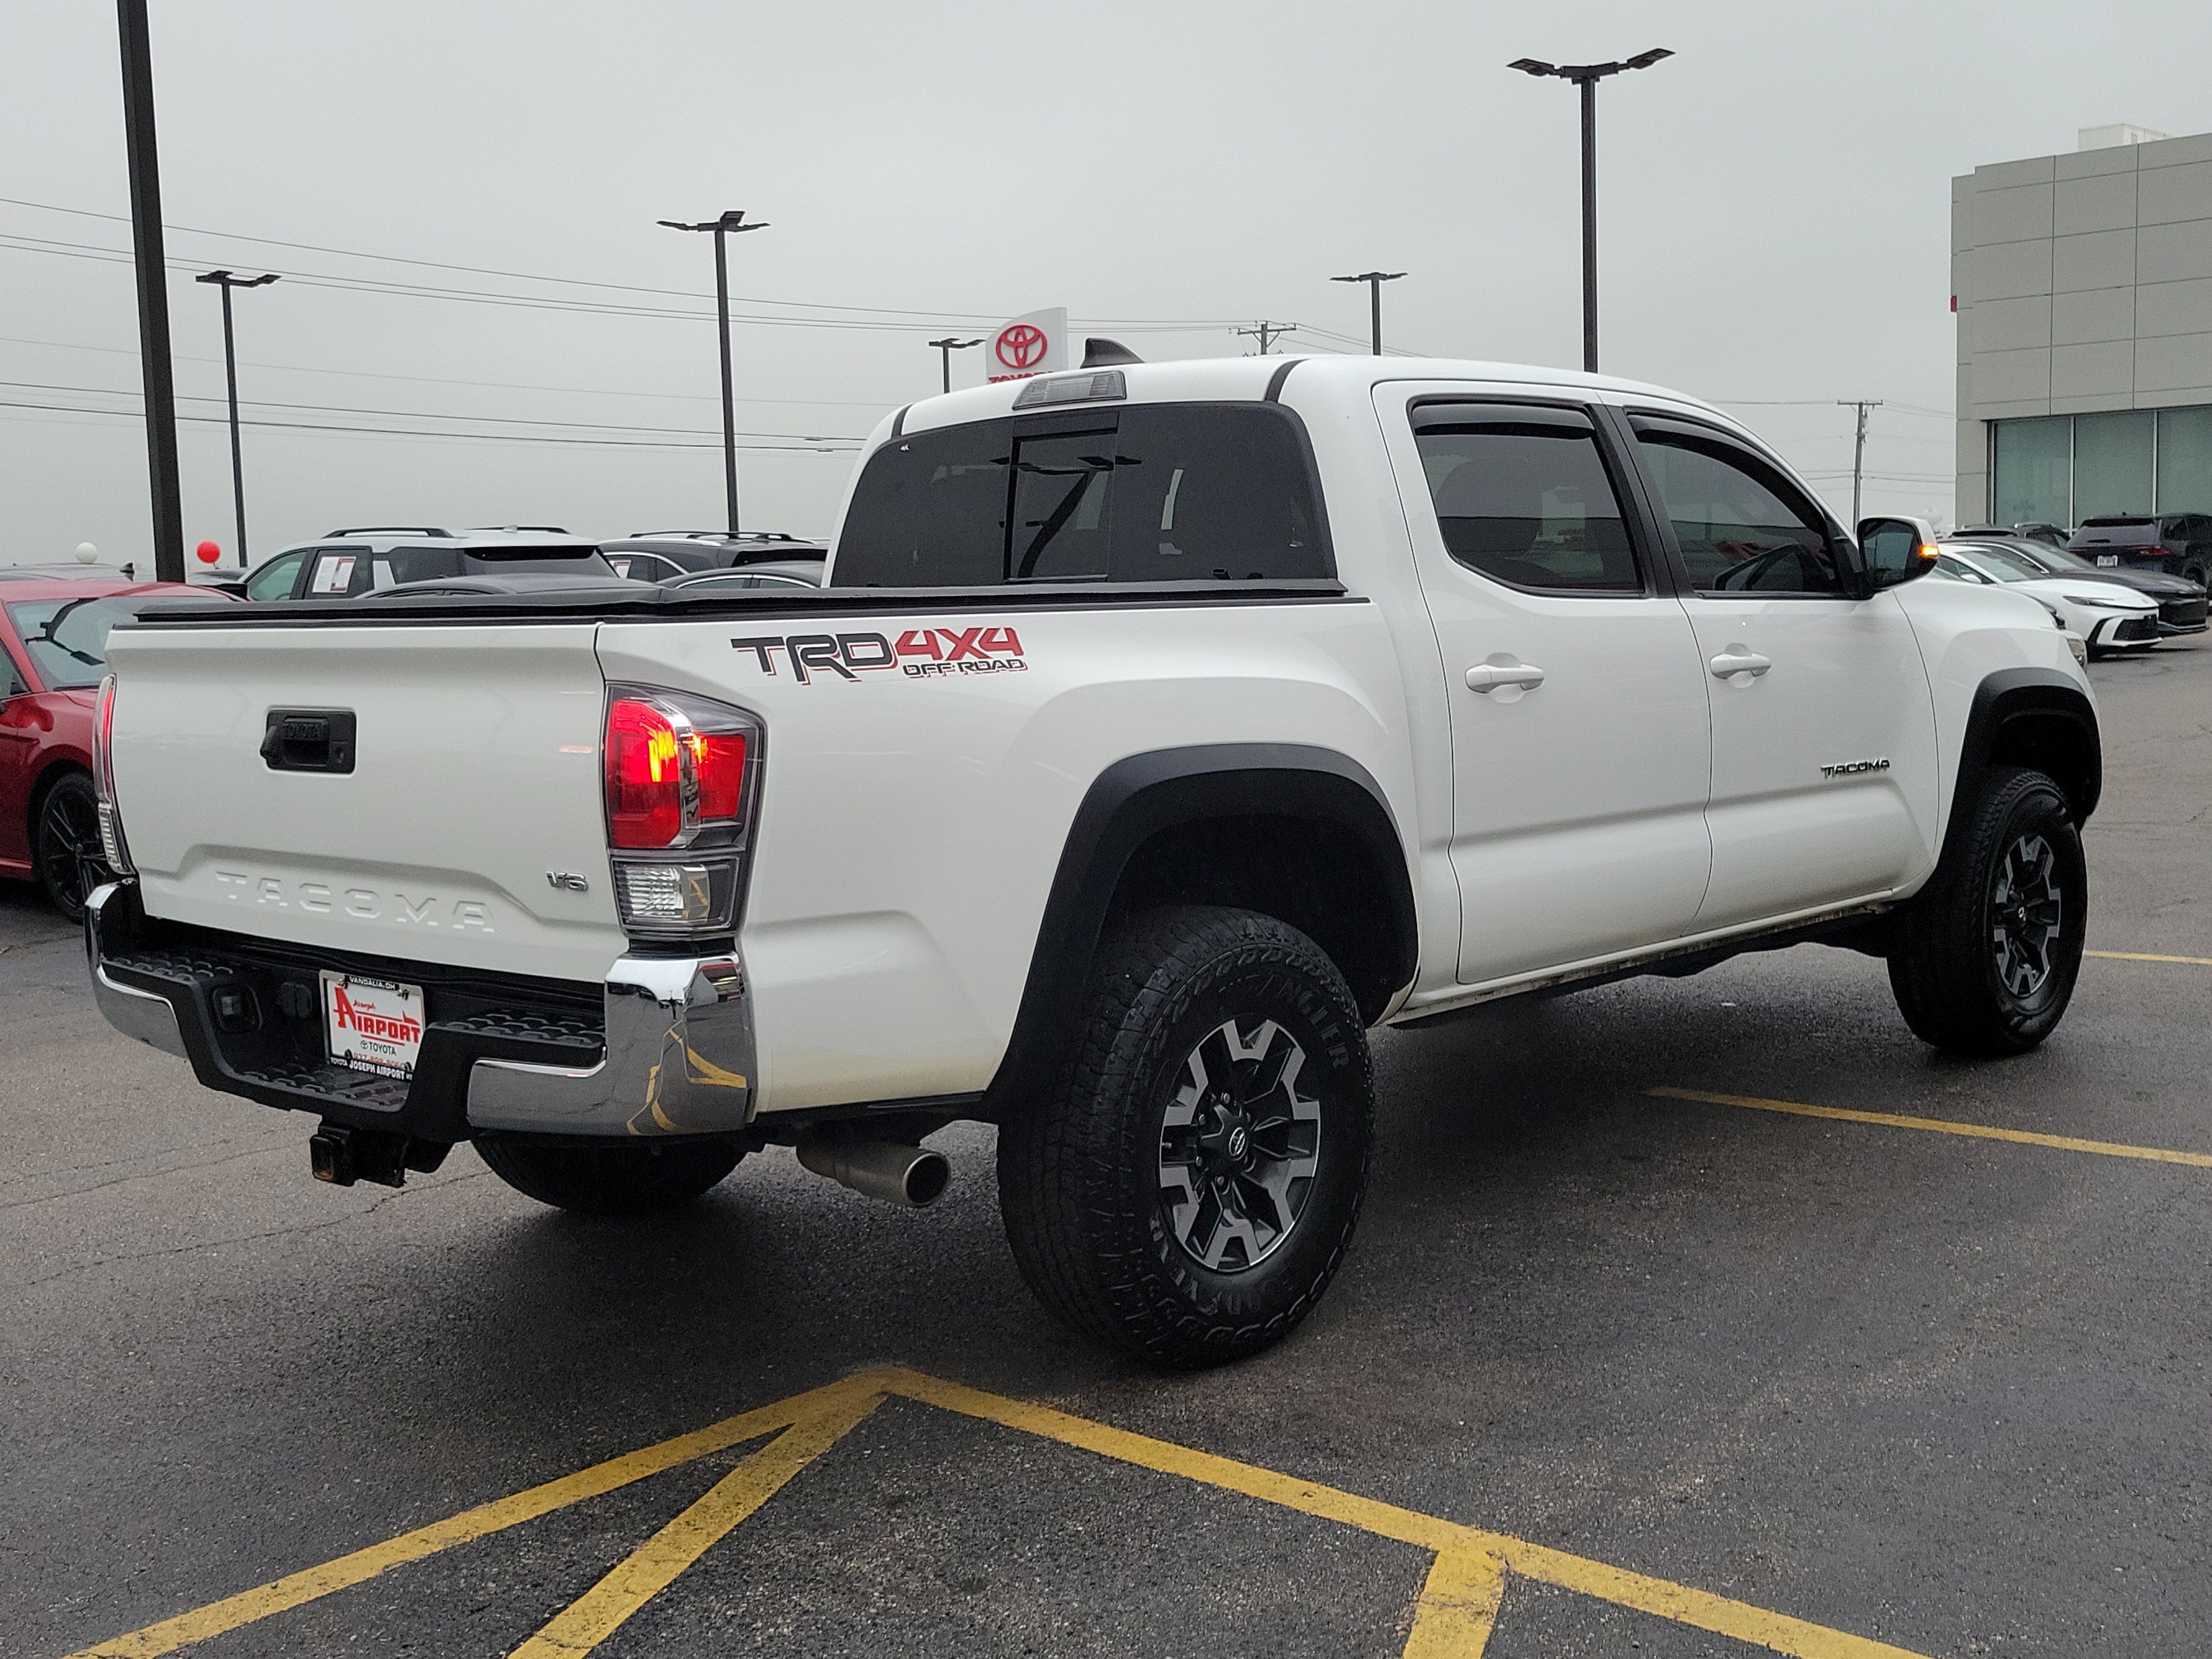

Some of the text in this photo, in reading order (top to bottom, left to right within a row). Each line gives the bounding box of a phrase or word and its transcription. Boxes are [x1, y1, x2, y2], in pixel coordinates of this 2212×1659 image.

[731, 633, 898, 685] TRD
[903, 659, 1029, 678] OFF ROAD
[1820, 757, 1891, 778] TACOMA
[546, 871, 589, 891] V6
[216, 871, 495, 933] TACOMA
[353, 1000, 375, 1011] Joseph
[369, 1041, 397, 1056] TOYOTA
[330, 1057, 347, 1067] TOYOTA
[349, 1060, 375, 1073] JOSEPH
[376, 1065, 405, 1081] AIRPORT
